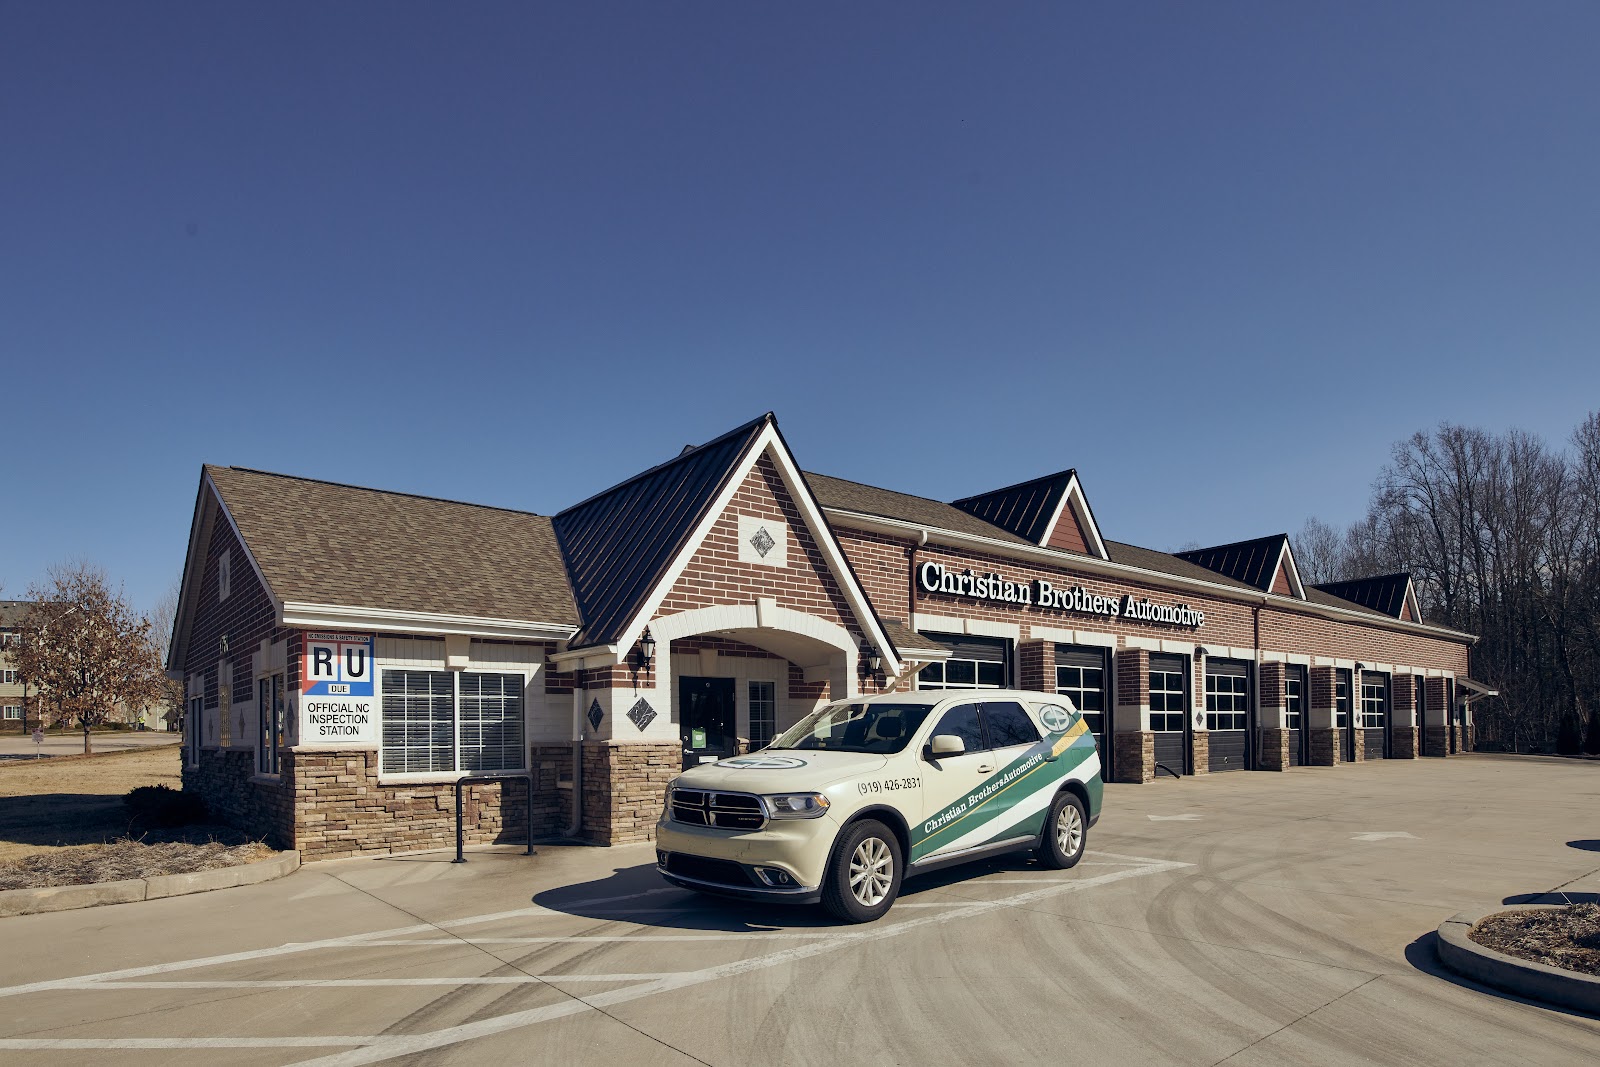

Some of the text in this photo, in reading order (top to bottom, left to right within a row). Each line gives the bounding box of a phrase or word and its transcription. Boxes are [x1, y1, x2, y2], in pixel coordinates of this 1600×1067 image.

[920, 561, 1205, 627] Christian Brothers Automotive
[313, 646, 365, 678] R U
[331, 685, 348, 693] DUE
[307, 702, 370, 713] OFFICIAL NC
[309, 714, 369, 724] INSPECTION
[319, 725, 360, 736] STATION
[857, 777, 922, 796] (919) 426-2831
[924, 802, 967, 834] Christian
